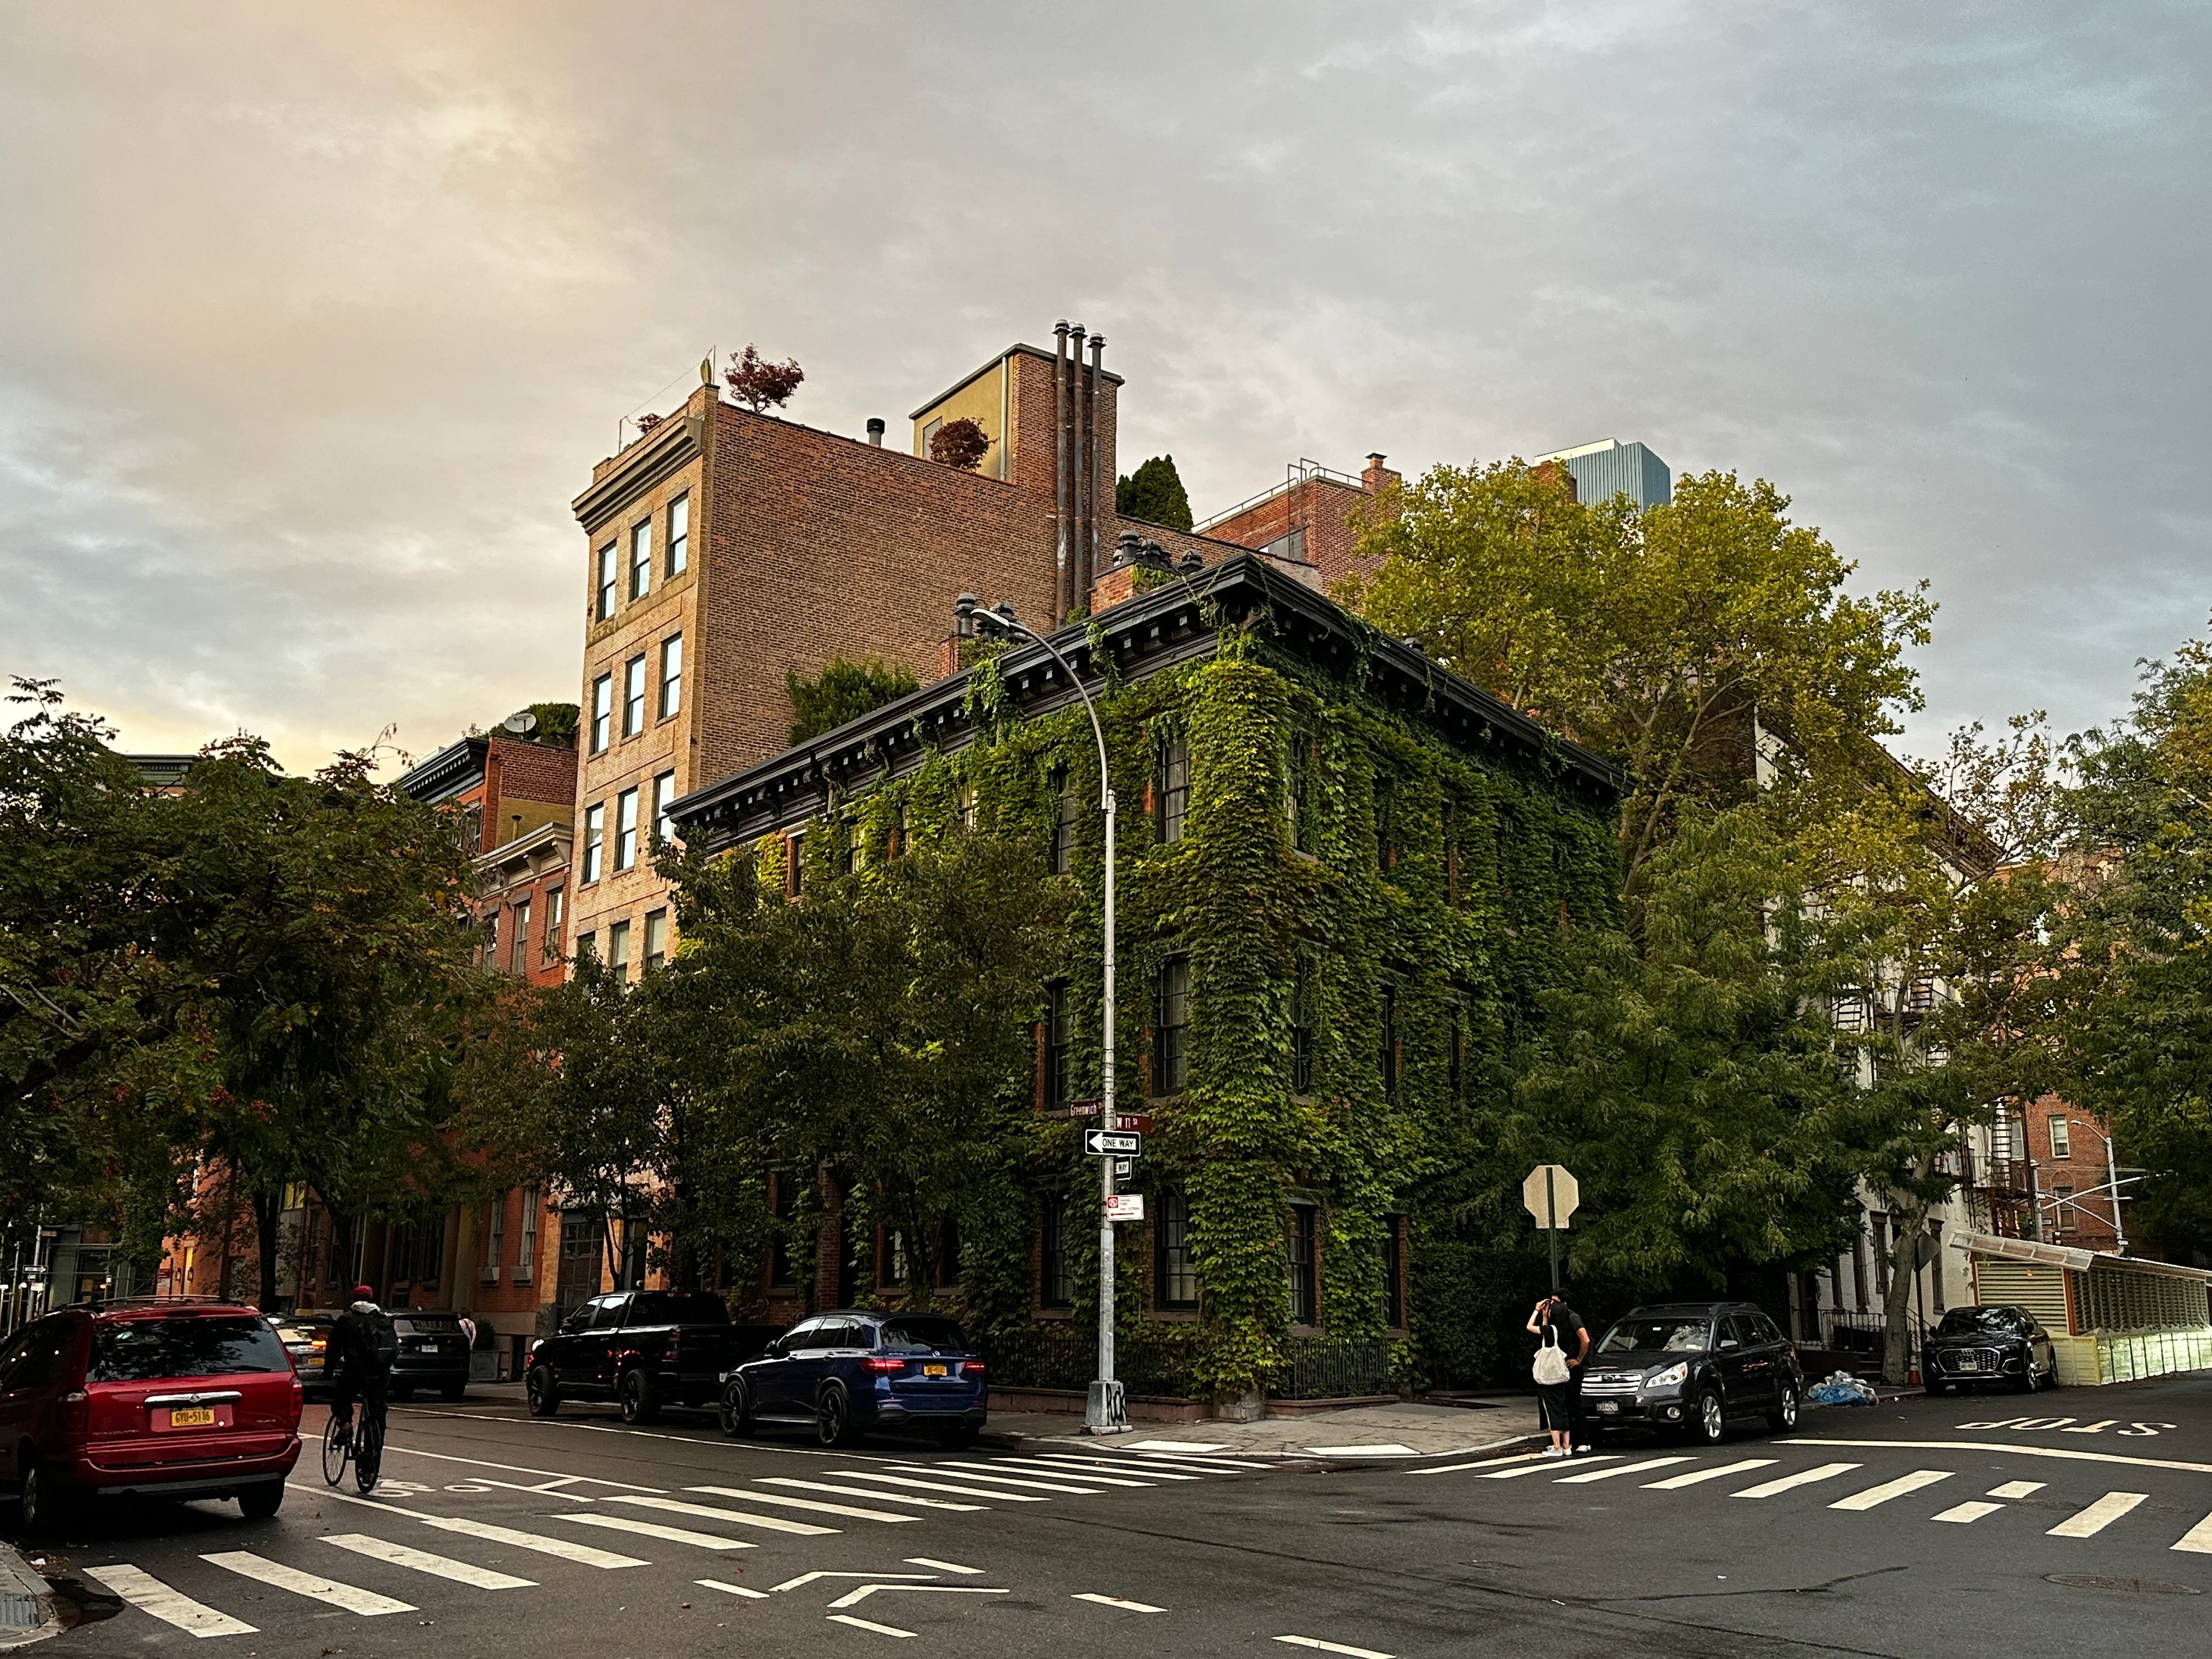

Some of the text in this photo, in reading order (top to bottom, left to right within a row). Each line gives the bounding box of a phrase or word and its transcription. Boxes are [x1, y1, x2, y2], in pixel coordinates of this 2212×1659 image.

[1070, 1103, 1097, 1116] Greenwich
[1116, 1117, 1122, 1128] W
[1125, 1118, 1130, 1128] 11
[1102, 1138, 1133, 1148] ONE WAY
[1118, 1164, 1127, 1172] WAY
[1955, 1417, 2177, 1436] STOP
